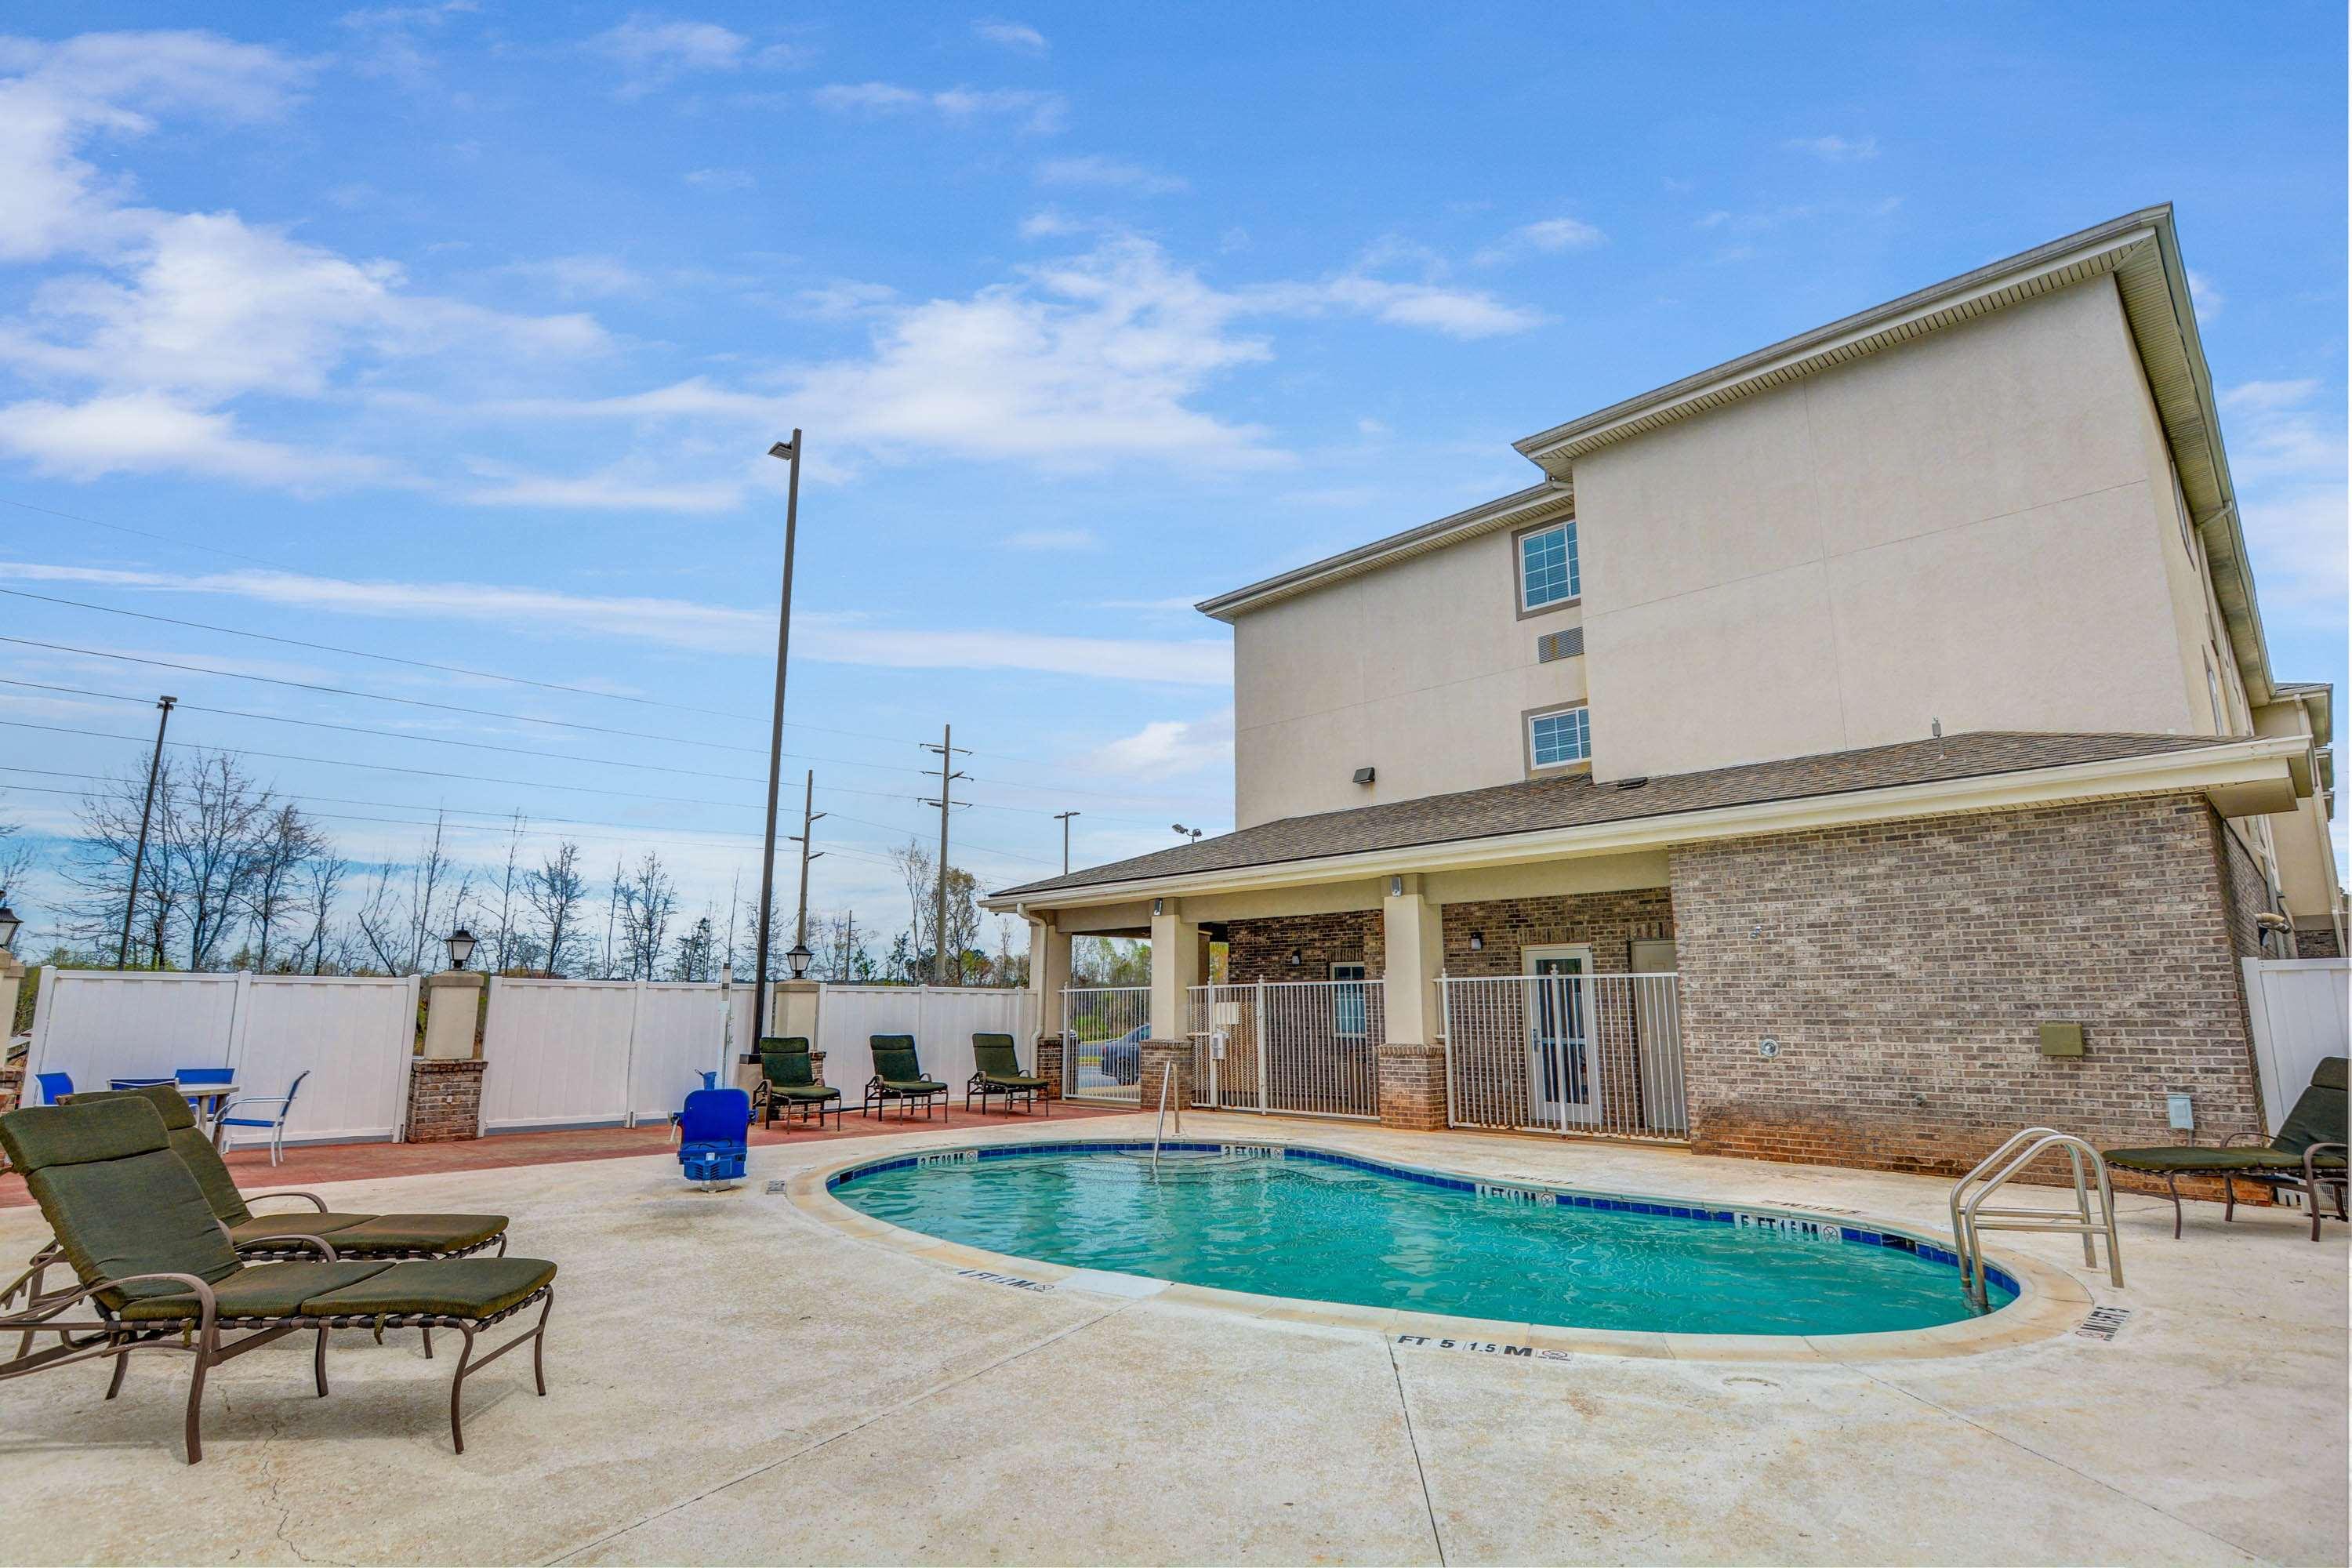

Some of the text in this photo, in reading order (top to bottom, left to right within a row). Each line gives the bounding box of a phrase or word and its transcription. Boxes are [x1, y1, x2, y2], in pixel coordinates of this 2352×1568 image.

[1235, 1145, 1247, 1156] FT
[1757, 1216, 1777, 1230] FT
[1801, 1221, 1819, 1241] M
[968, 1272, 1000, 1280] FT
[1007, 1279, 1037, 1288] M
[1396, 1335, 1534, 1357] FT 5 1.5 M
